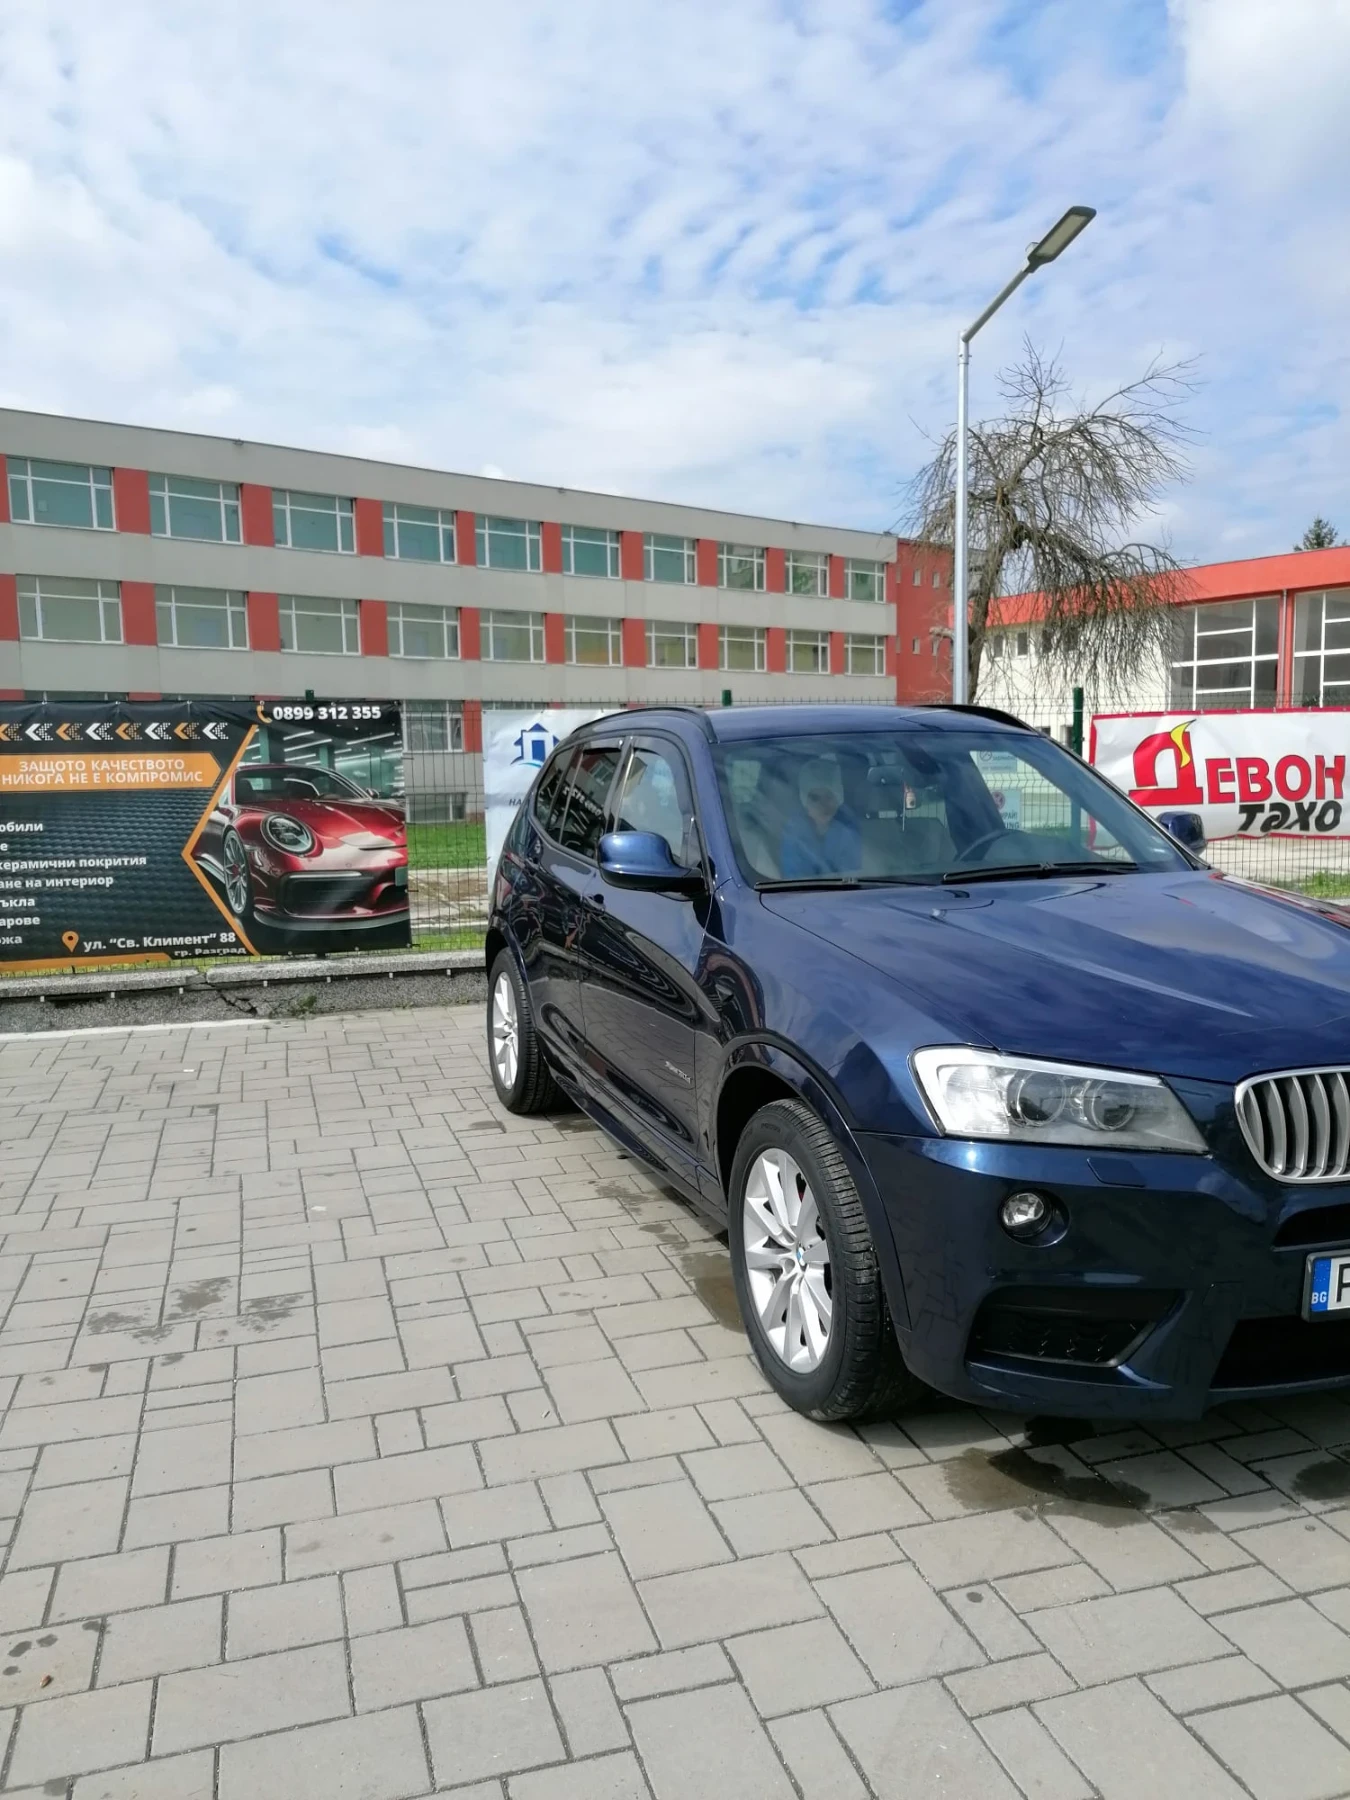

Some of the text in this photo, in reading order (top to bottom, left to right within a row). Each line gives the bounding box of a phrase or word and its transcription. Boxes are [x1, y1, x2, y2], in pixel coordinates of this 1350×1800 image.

[272, 706, 382, 720] 0899 312 355
[19, 759, 185, 774] ЗАЩОТО КАЧЕСТВОТО
[1128, 719, 1346, 806] ДЕВОН
[2, 771, 203, 785] НИКОГА НЕ Е КОМПРОМИС
[79, 856, 147, 869] покрития
[25, 879, 42, 888] на
[46, 876, 114, 888] интериор
[0, 935, 23, 944] жа
[83, 941, 106, 952] ул.
[220, 932, 236, 943] 88
[195, 947, 247, 956] Разград
[1311, 1291, 1327, 1304] BG
